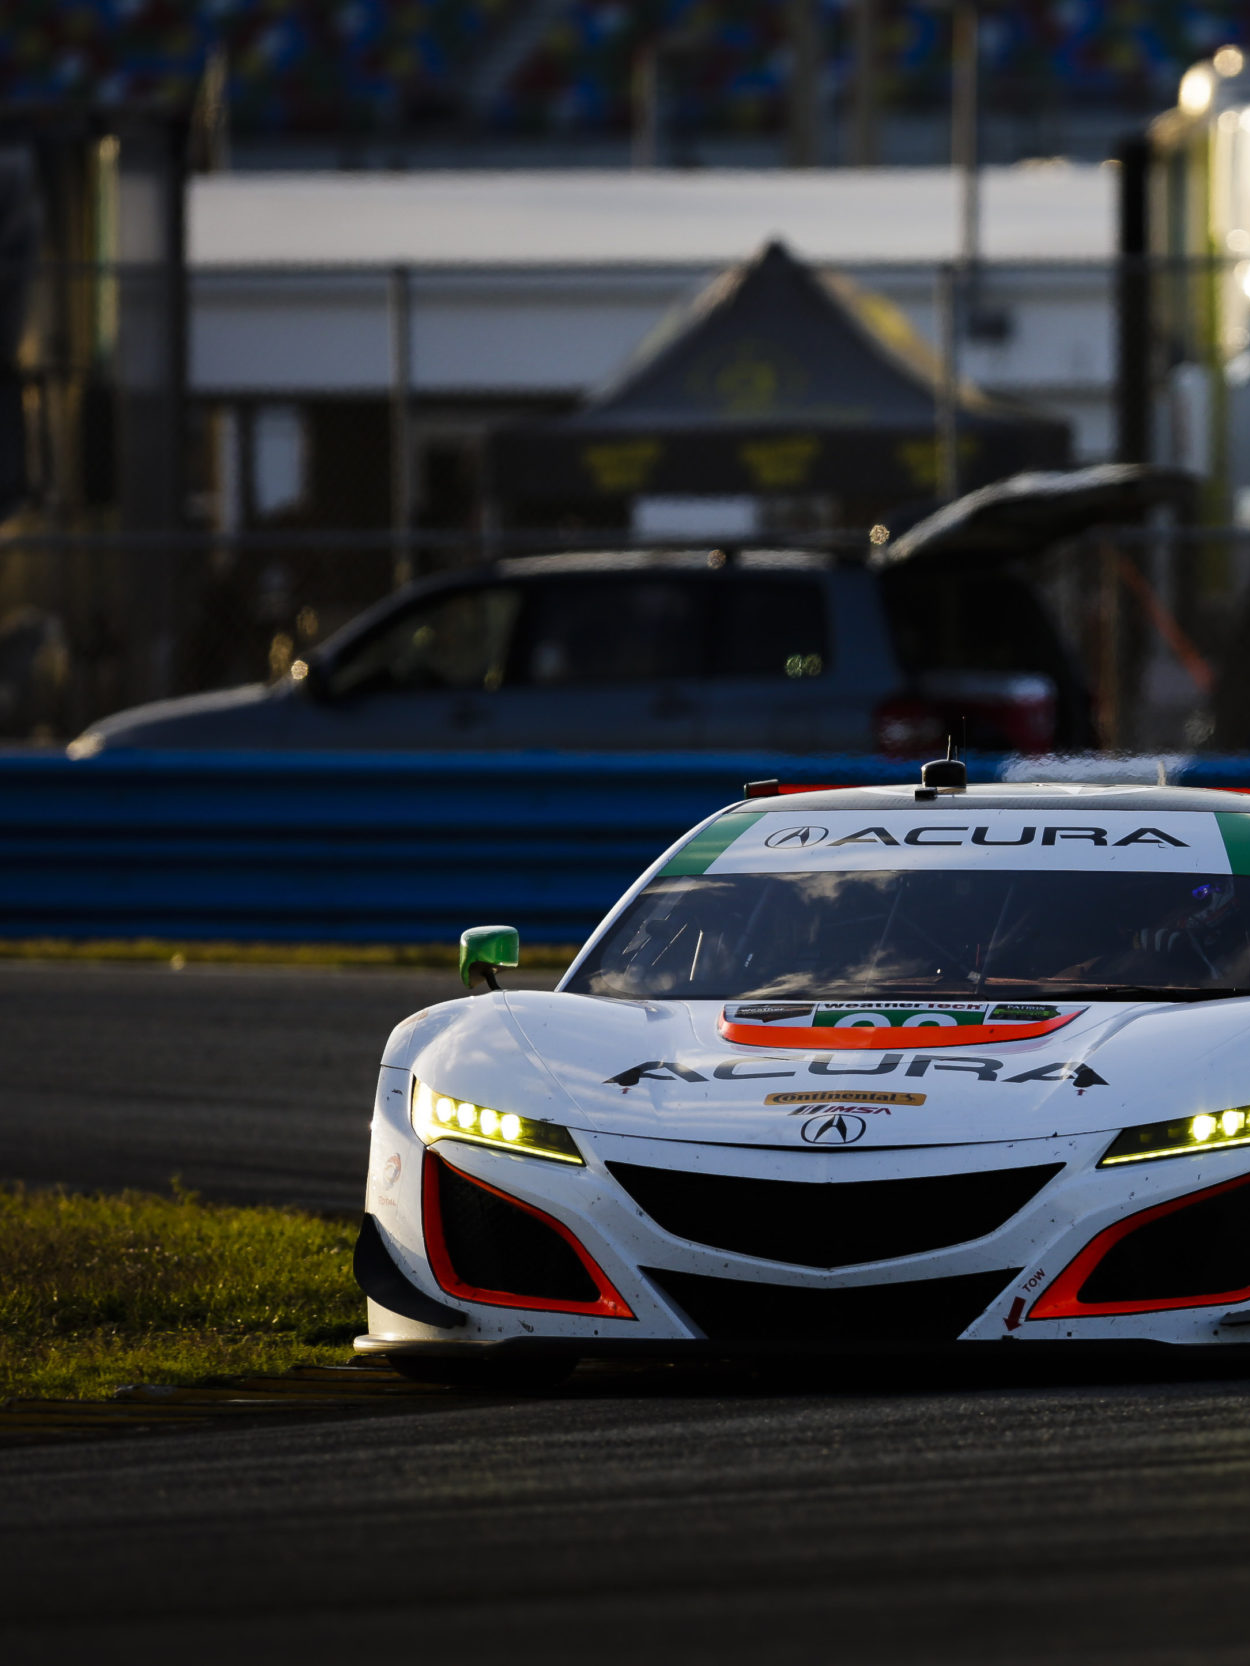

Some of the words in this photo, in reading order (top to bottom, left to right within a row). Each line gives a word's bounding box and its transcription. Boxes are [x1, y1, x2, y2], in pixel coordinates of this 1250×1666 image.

[826, 826, 1192, 848] ACURA
[602, 1053, 1110, 1087] ACURA
[772, 1091, 897, 1103] Continental
[822, 1105, 892, 1116] IMSA
[1022, 1268, 1046, 1293] TOW
